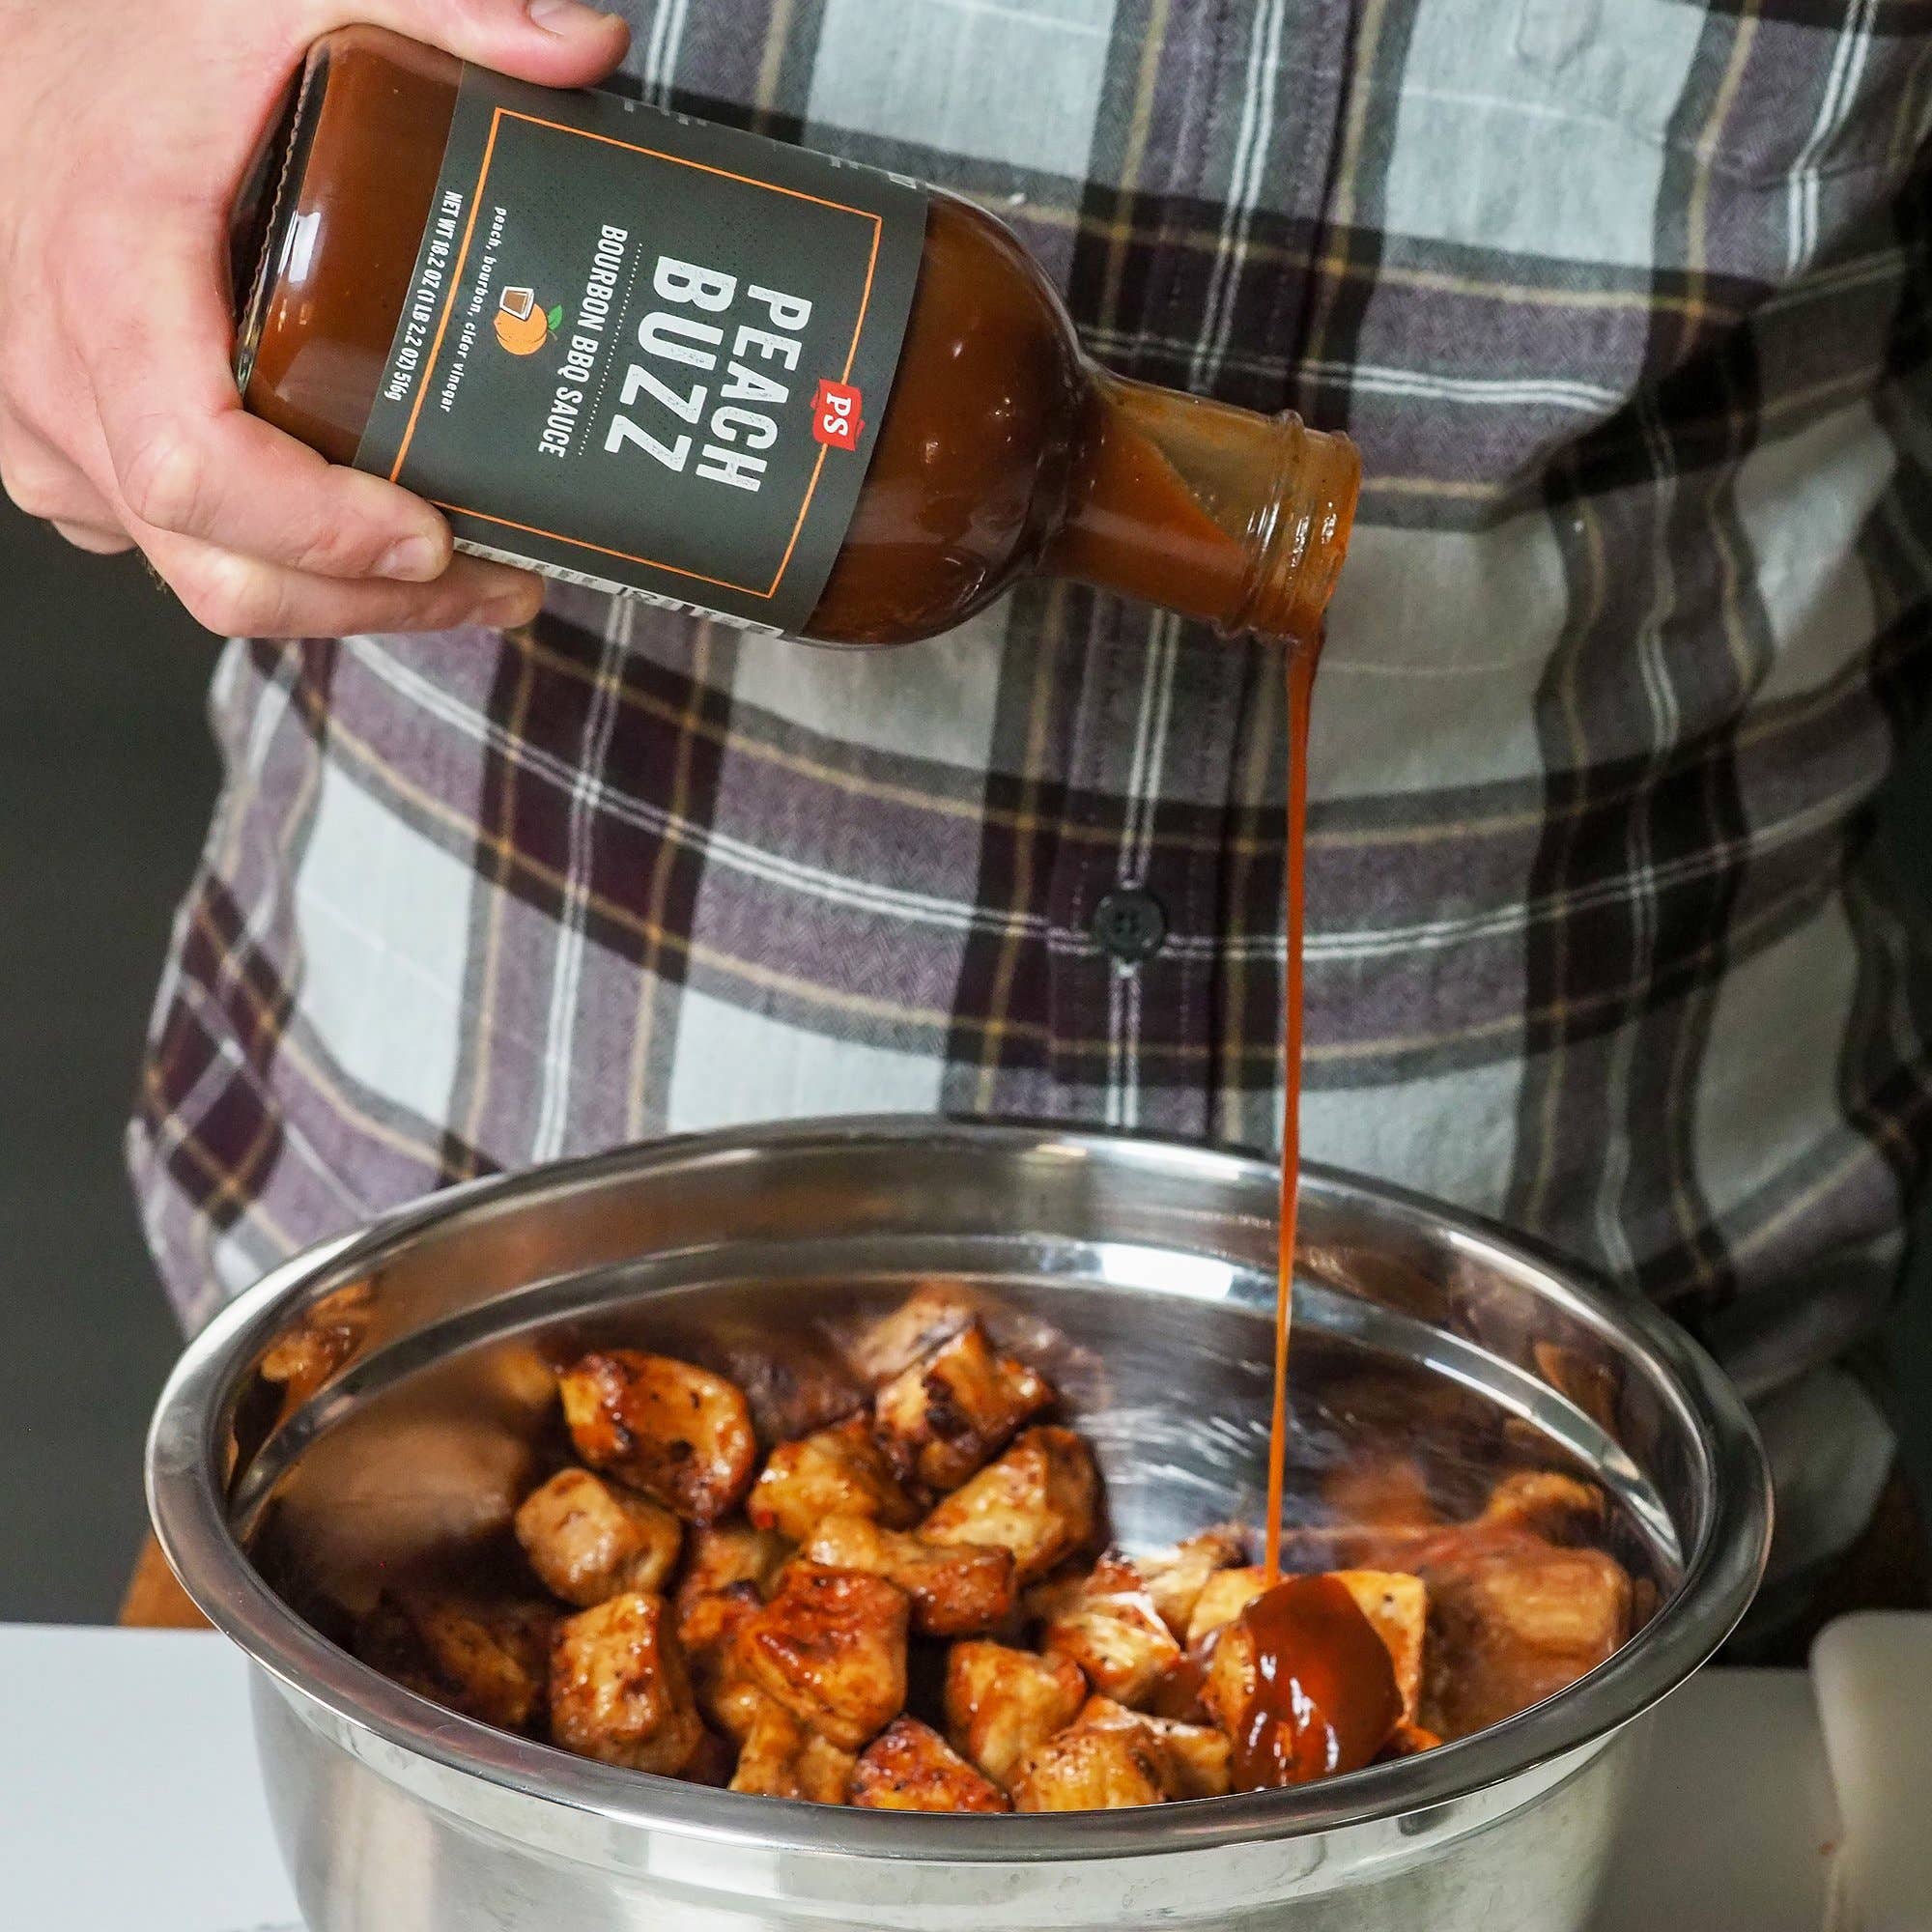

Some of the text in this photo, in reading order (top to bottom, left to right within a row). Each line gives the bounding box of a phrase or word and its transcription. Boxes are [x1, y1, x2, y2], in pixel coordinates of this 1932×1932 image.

[384, 190, 464, 402] NET WT 18.2 OZ (1 LB 2.2 OZ) 516g
[440, 206, 507, 412] peach, bourbon, cider vinegar
[538, 224, 628, 458] BOURBON BBQ SAUCE
[604, 255, 738, 472] BUZZ
[696, 284, 812, 492] PEACH
[823, 392, 852, 437] PS
